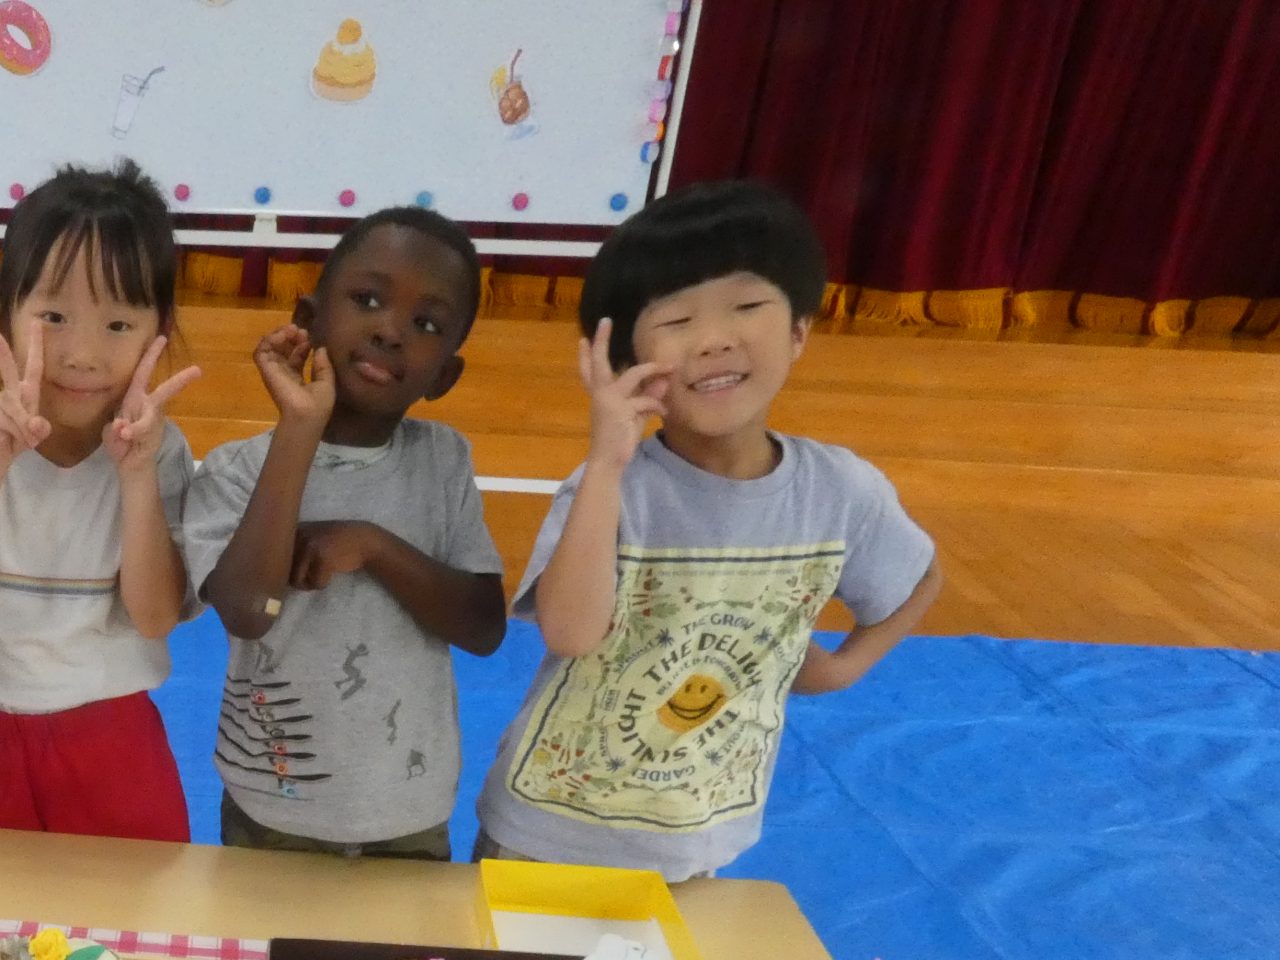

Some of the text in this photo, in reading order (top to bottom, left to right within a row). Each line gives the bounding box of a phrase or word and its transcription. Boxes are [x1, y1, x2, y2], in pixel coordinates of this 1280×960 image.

[710, 612, 756, 631] GROW
[642, 639, 692, 682] THE
[698, 632, 763, 690] DELIGH
